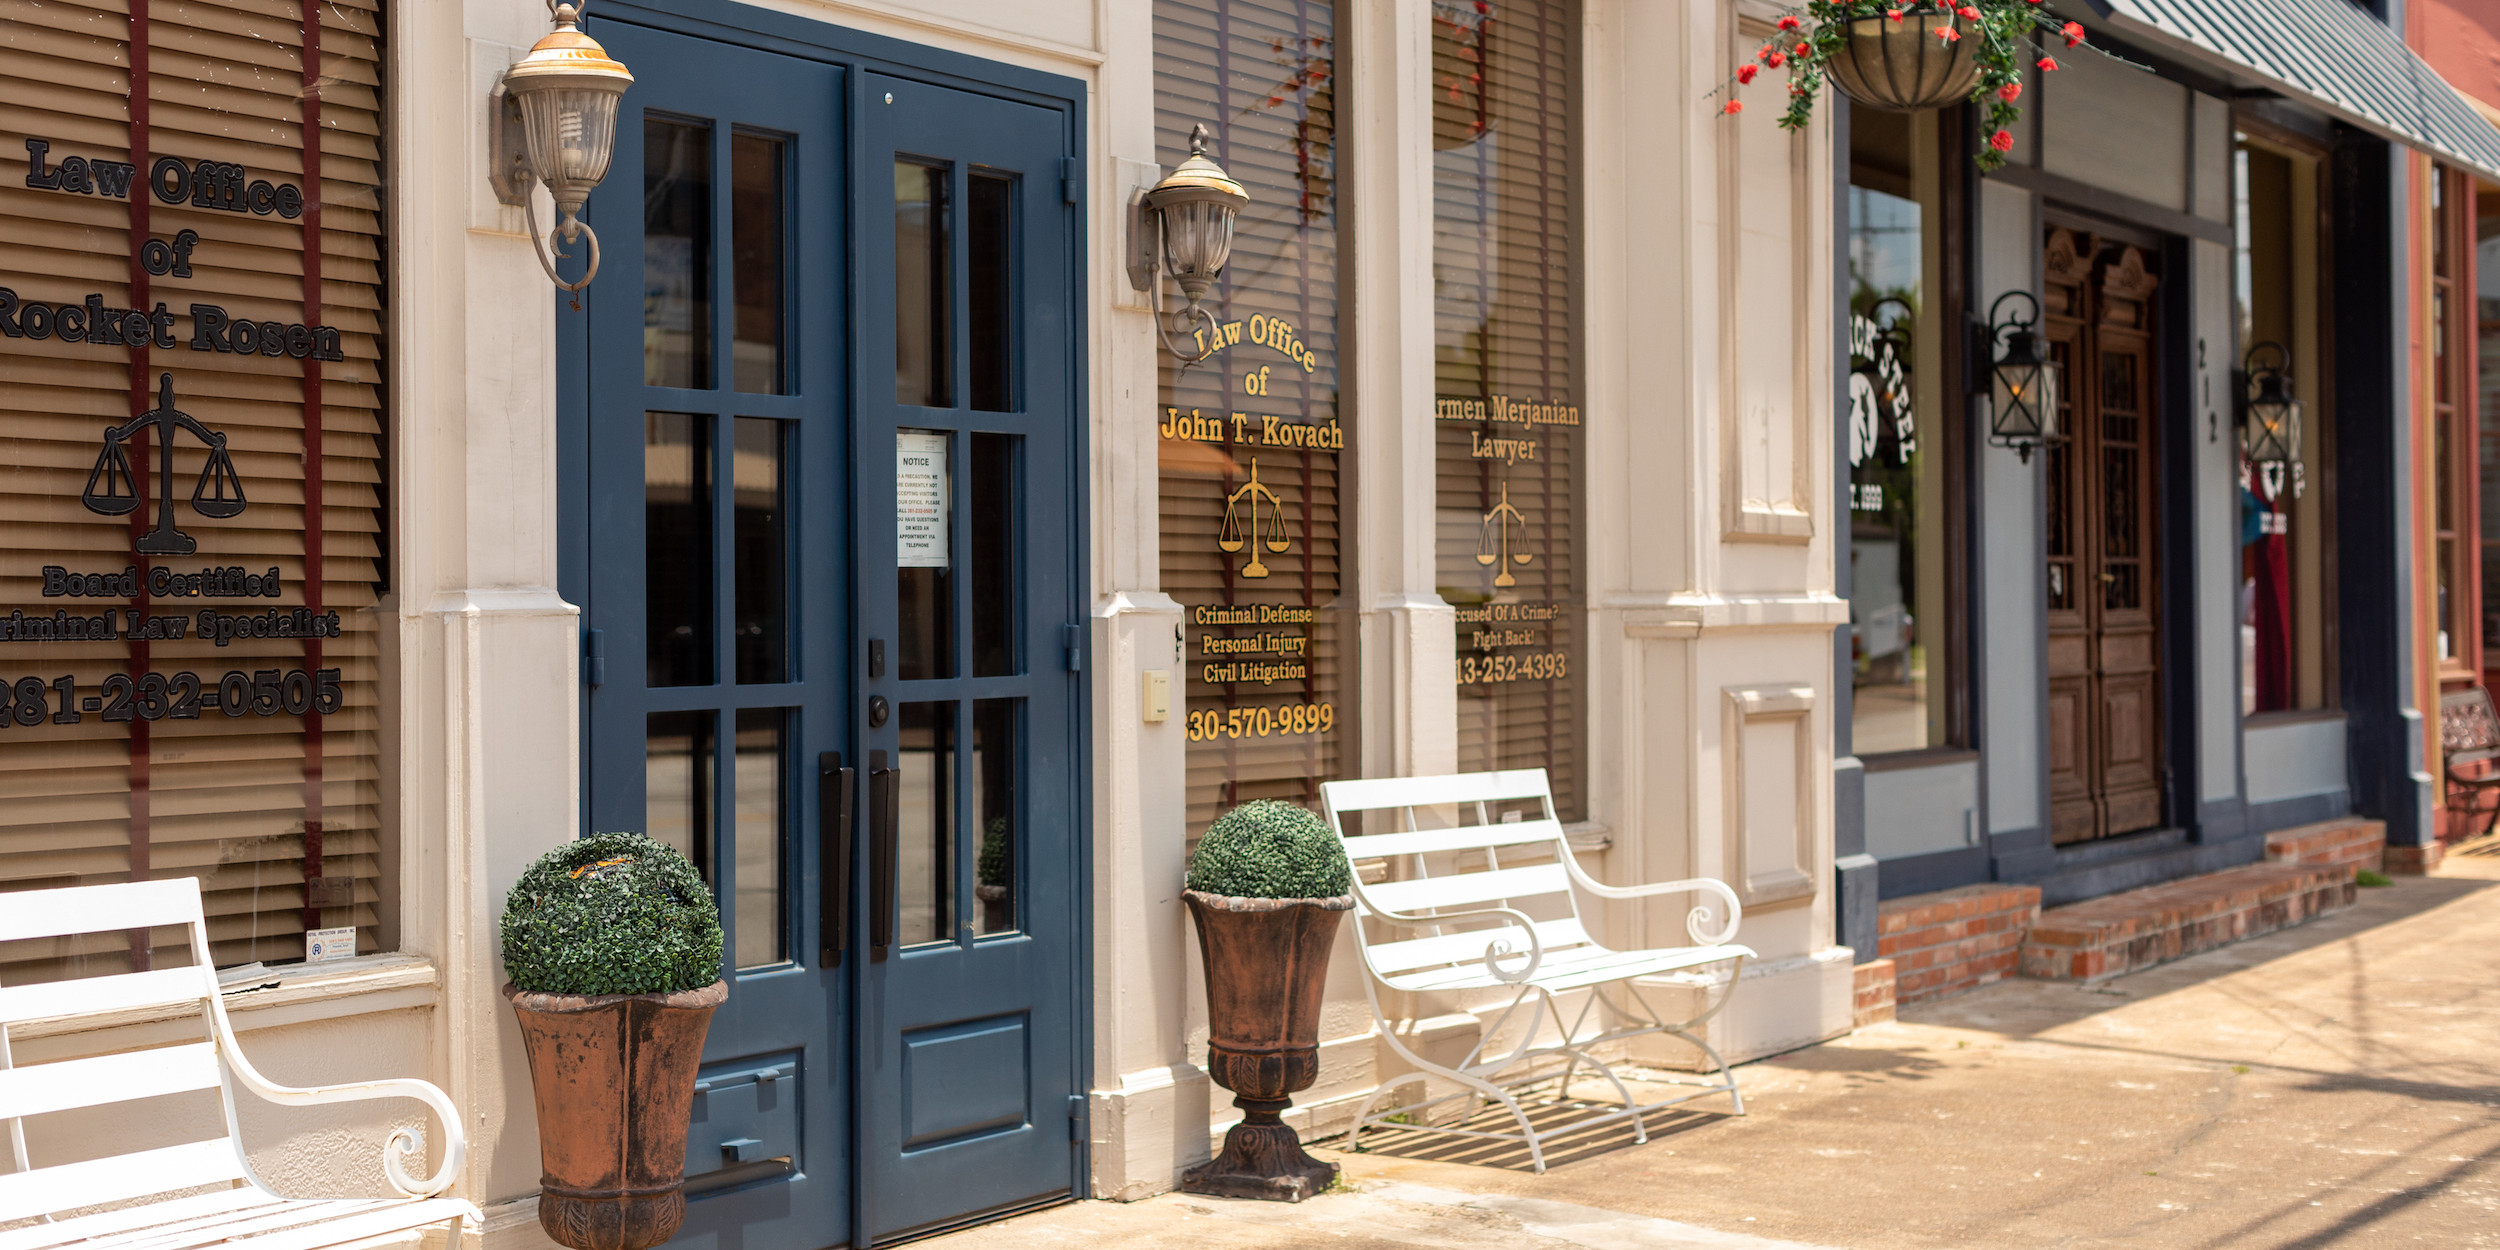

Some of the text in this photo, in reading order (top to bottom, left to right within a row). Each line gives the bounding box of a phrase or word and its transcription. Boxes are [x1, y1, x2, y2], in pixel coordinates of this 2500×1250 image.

[26, 138, 302, 219] Law Office
[141, 229, 199, 278] of
[0, 287, 343, 361] Rocket Rosen
[1194, 313, 1316, 373] Law Office
[1244, 365, 1270, 396] of
[1161, 407, 1344, 449] John T. Kovach
[1435, 395, 1580, 431] rmen Merjanian
[903, 457, 930, 466] NOTICE
[1472, 431, 1536, 467] Lawyer
[42, 565, 281, 598] Board Certified
[0, 607, 341, 646] riminal Law Specialist
[1195, 604, 1313, 625] Criminal Defense
[1455, 604, 1559, 623] ccused Of A Crime?
[1202, 631, 1307, 656] Personal Injury
[1473, 629, 1535, 651] Fight Back!
[1203, 661, 1306, 685] Civil Litigation
[1456, 652, 1566, 685] 13-252-4393
[1185, 703, 1334, 742] 30-570-9899
